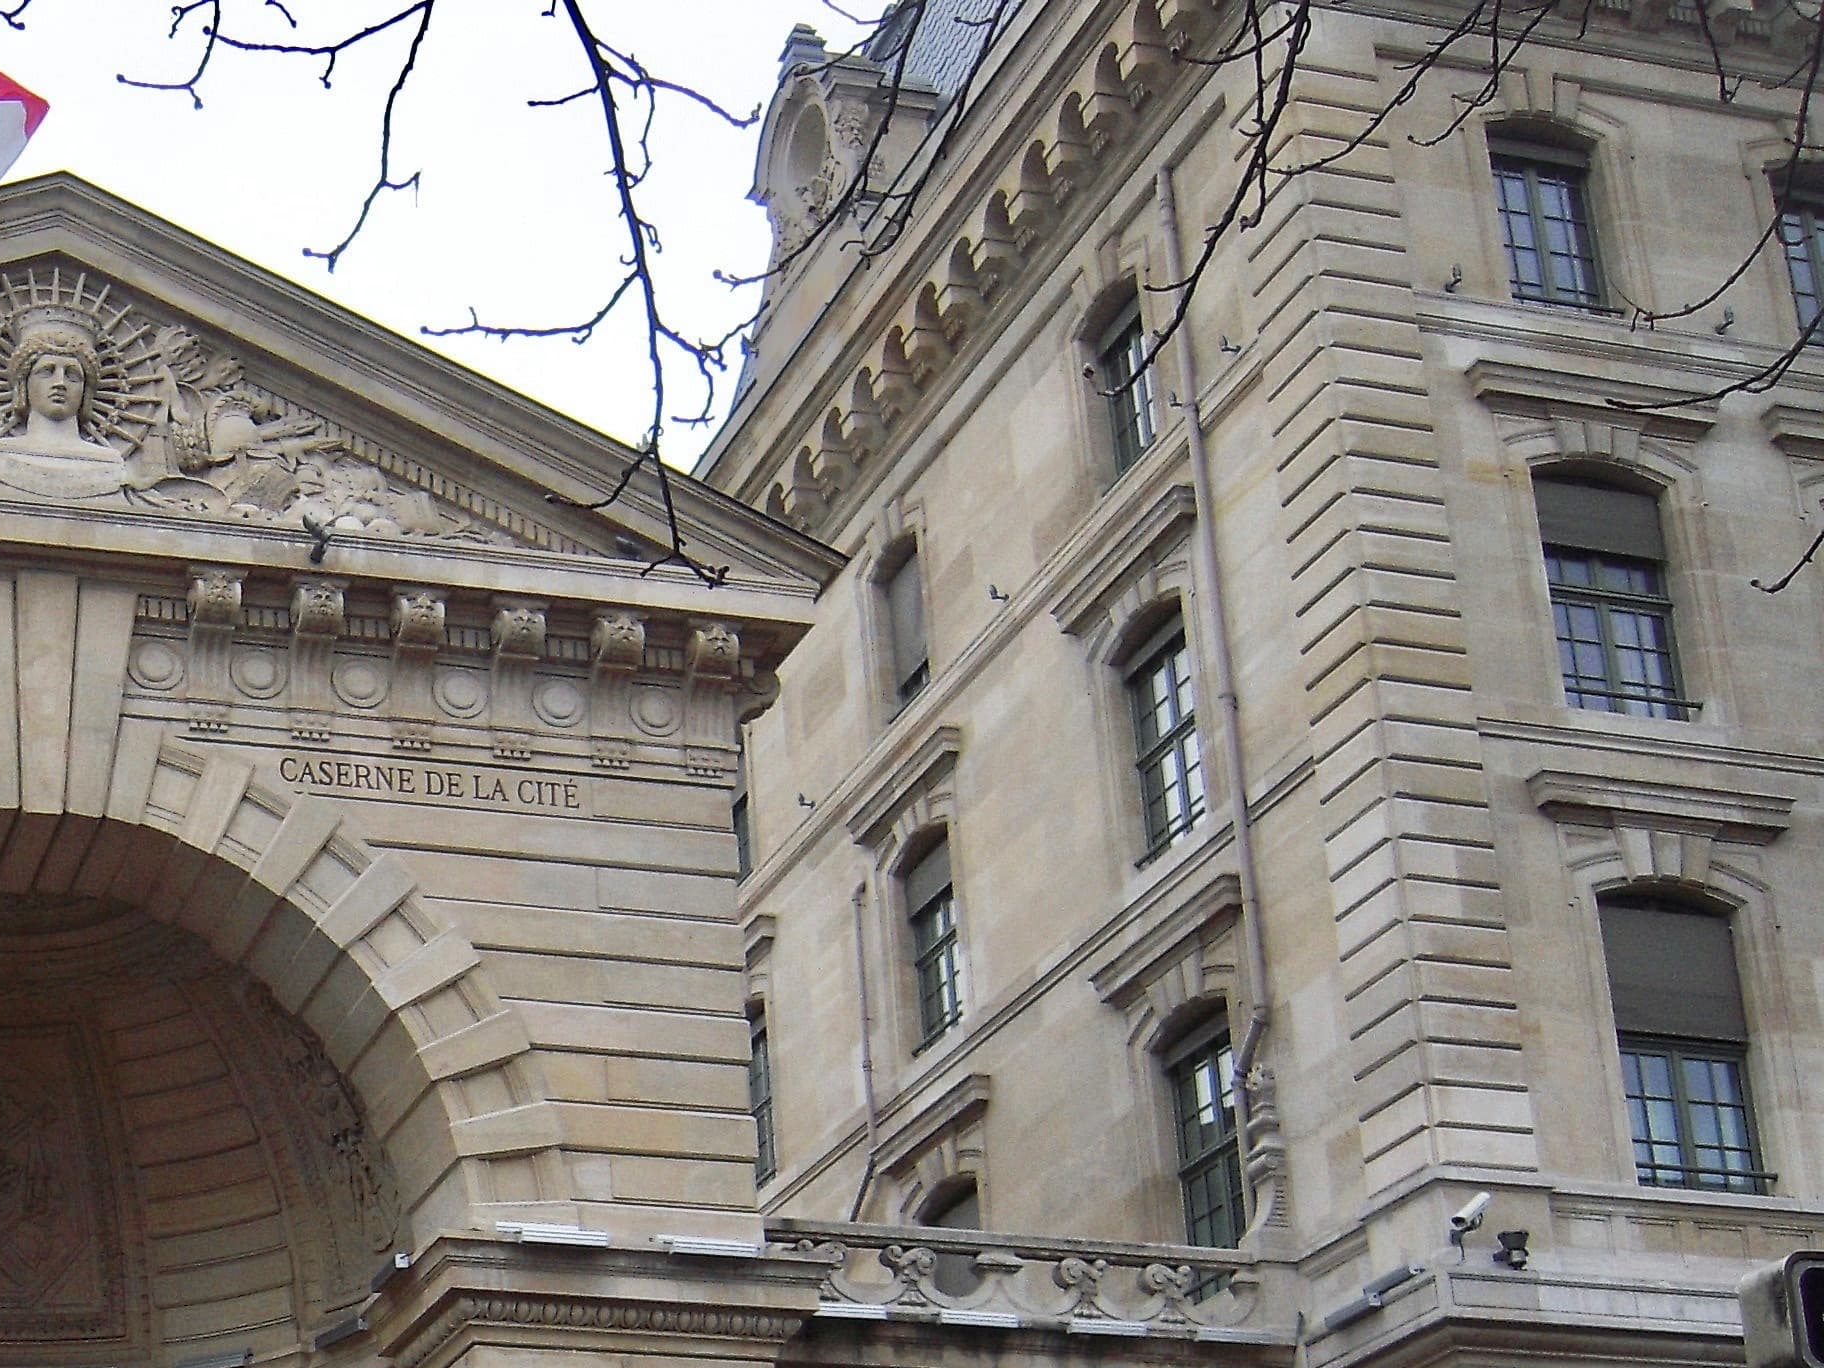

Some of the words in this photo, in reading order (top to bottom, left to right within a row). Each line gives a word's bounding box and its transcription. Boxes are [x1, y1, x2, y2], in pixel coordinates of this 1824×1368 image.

[279, 757, 416, 794] CASERNE
[425, 769, 464, 798] DE
[473, 774, 509, 802] LA
[517, 778, 580, 809] CITÉ
